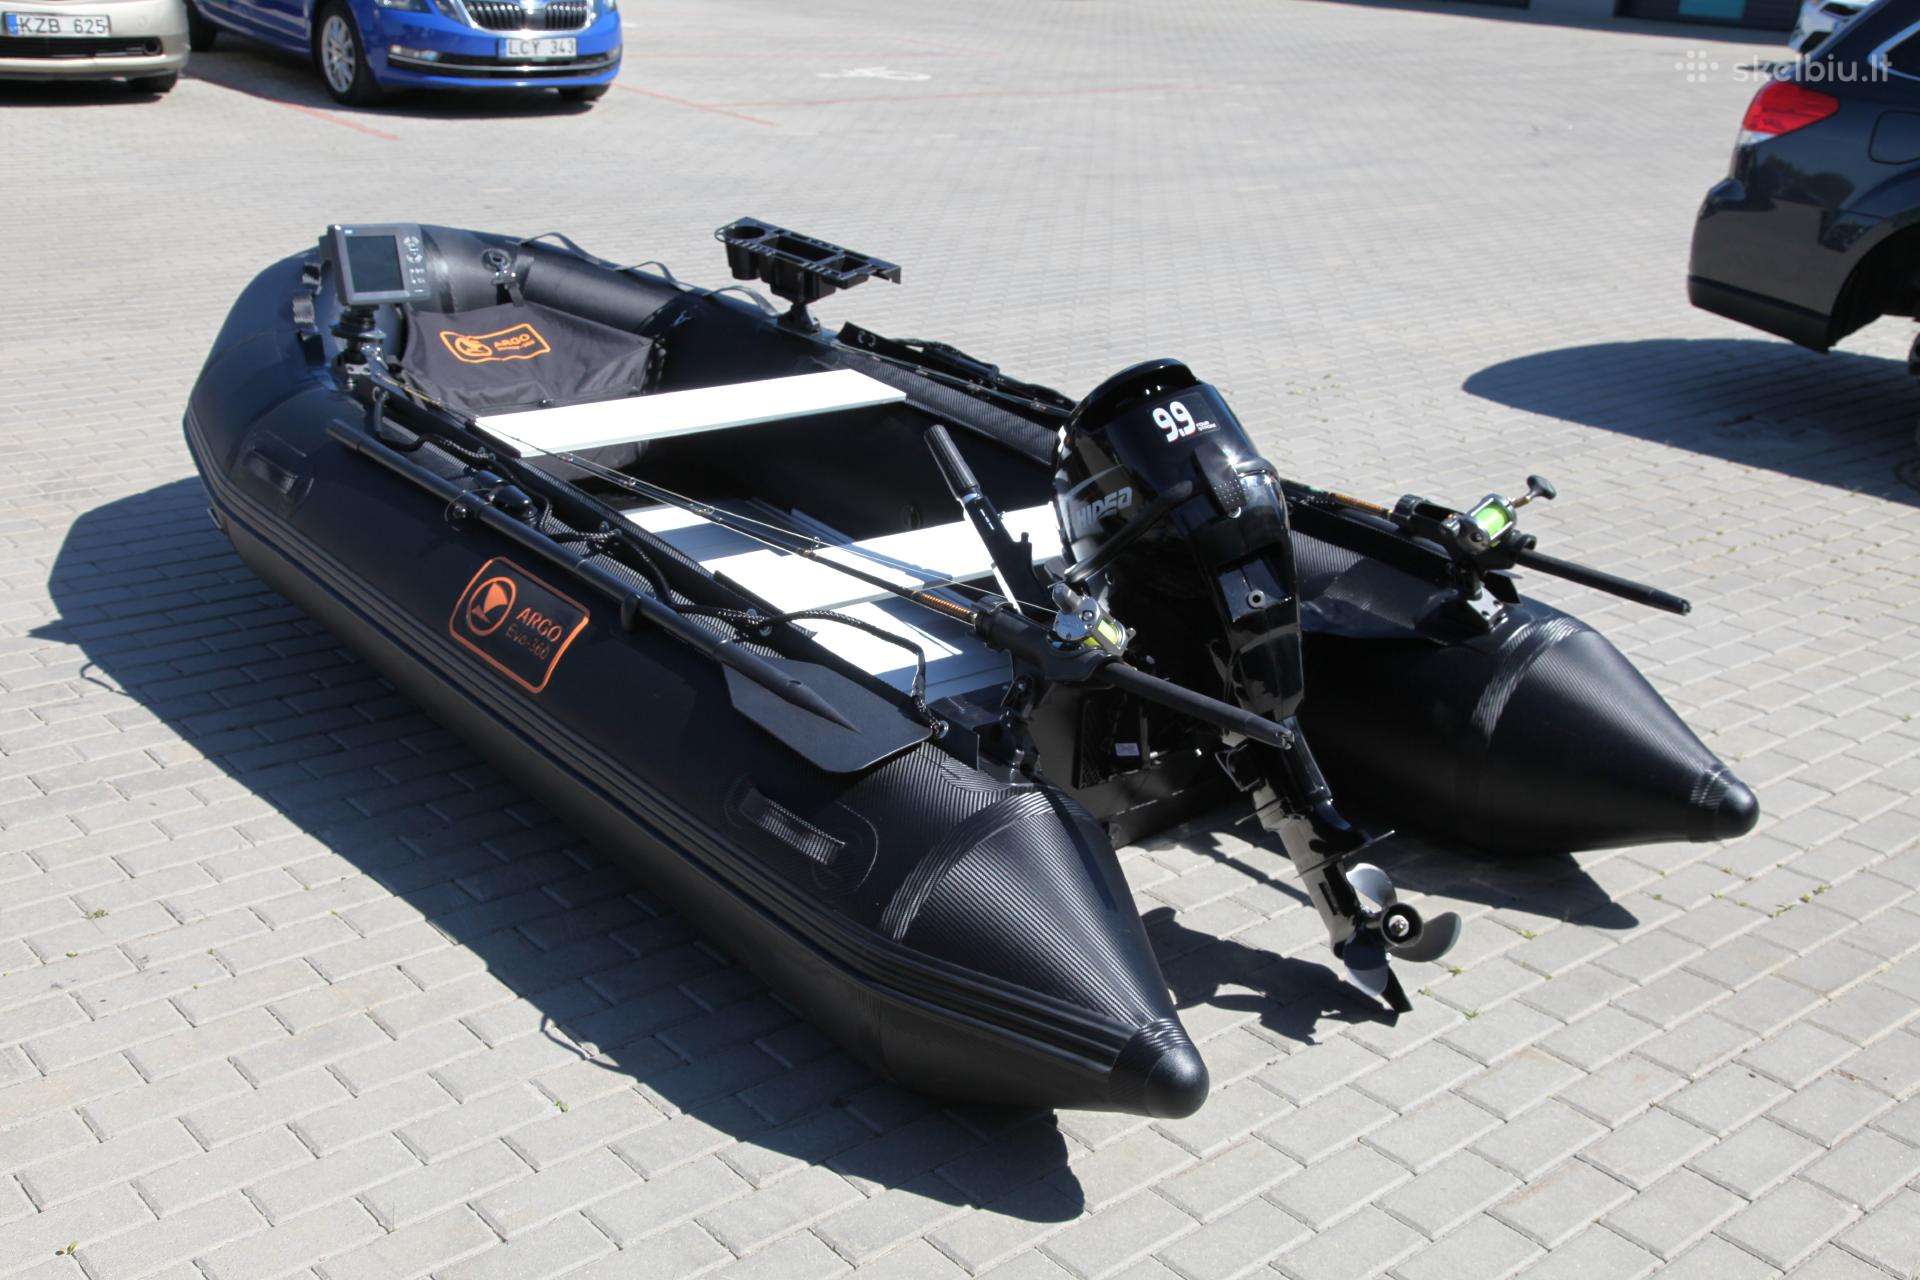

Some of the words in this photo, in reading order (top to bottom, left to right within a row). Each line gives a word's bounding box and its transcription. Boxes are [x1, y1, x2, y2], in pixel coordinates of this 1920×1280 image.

[20, 17, 61, 33] KZB
[73, 18, 106, 34] 625
[508, 40, 540, 55] LCY
[550, 40, 574, 54] 343
[515, 607, 562, 642] ARGO
